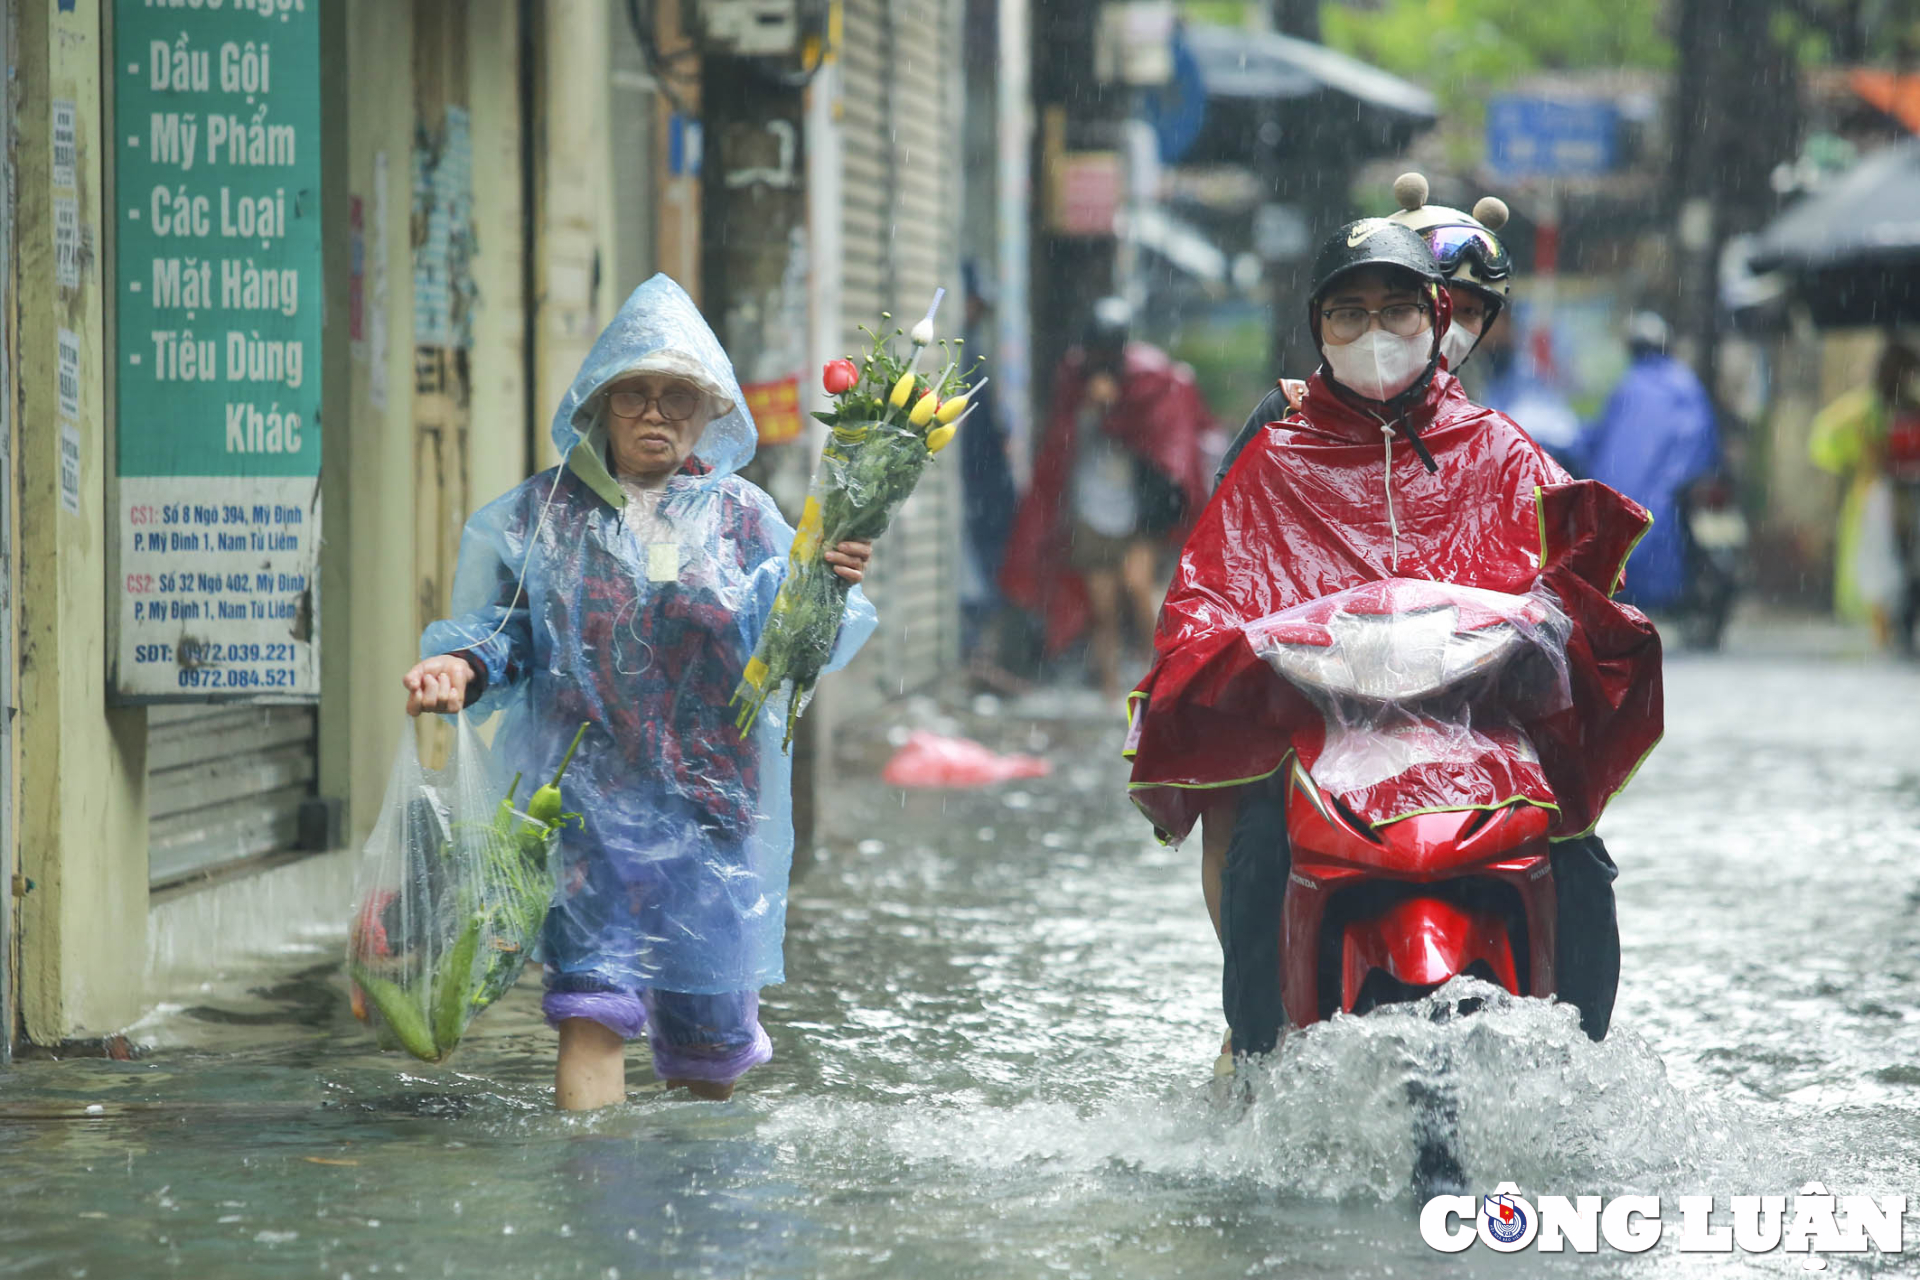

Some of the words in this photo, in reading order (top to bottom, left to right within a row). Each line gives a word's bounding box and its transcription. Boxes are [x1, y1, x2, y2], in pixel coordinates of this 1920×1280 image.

[150, 31, 209, 92] Dầu
[220, 41, 270, 104] Gội
[150, 112, 198, 171] Mỹ
[207, 103, 296, 167] Phẩm
[151, 184, 210, 237] Các
[220, 186, 286, 249] Loại
[152, 256, 212, 321] Mặt
[221, 257, 299, 317] Hàng
[151, 329, 216, 381] Tiêu
[226, 329, 303, 388] Dùng
[225, 402, 302, 453] Khác
[130, 505, 159, 526] CS1:
[163, 501, 180, 525] Số
[183, 505, 190, 525] 8
[135, 532, 145, 552] P.
[218, 532, 247, 552] Nam
[159, 570, 176, 594] Số
[179, 573, 195, 593] 32
[135, 601, 145, 621] P.
[218, 601, 247, 620] Nam
[178, 669, 295, 688] 0972.084.521
